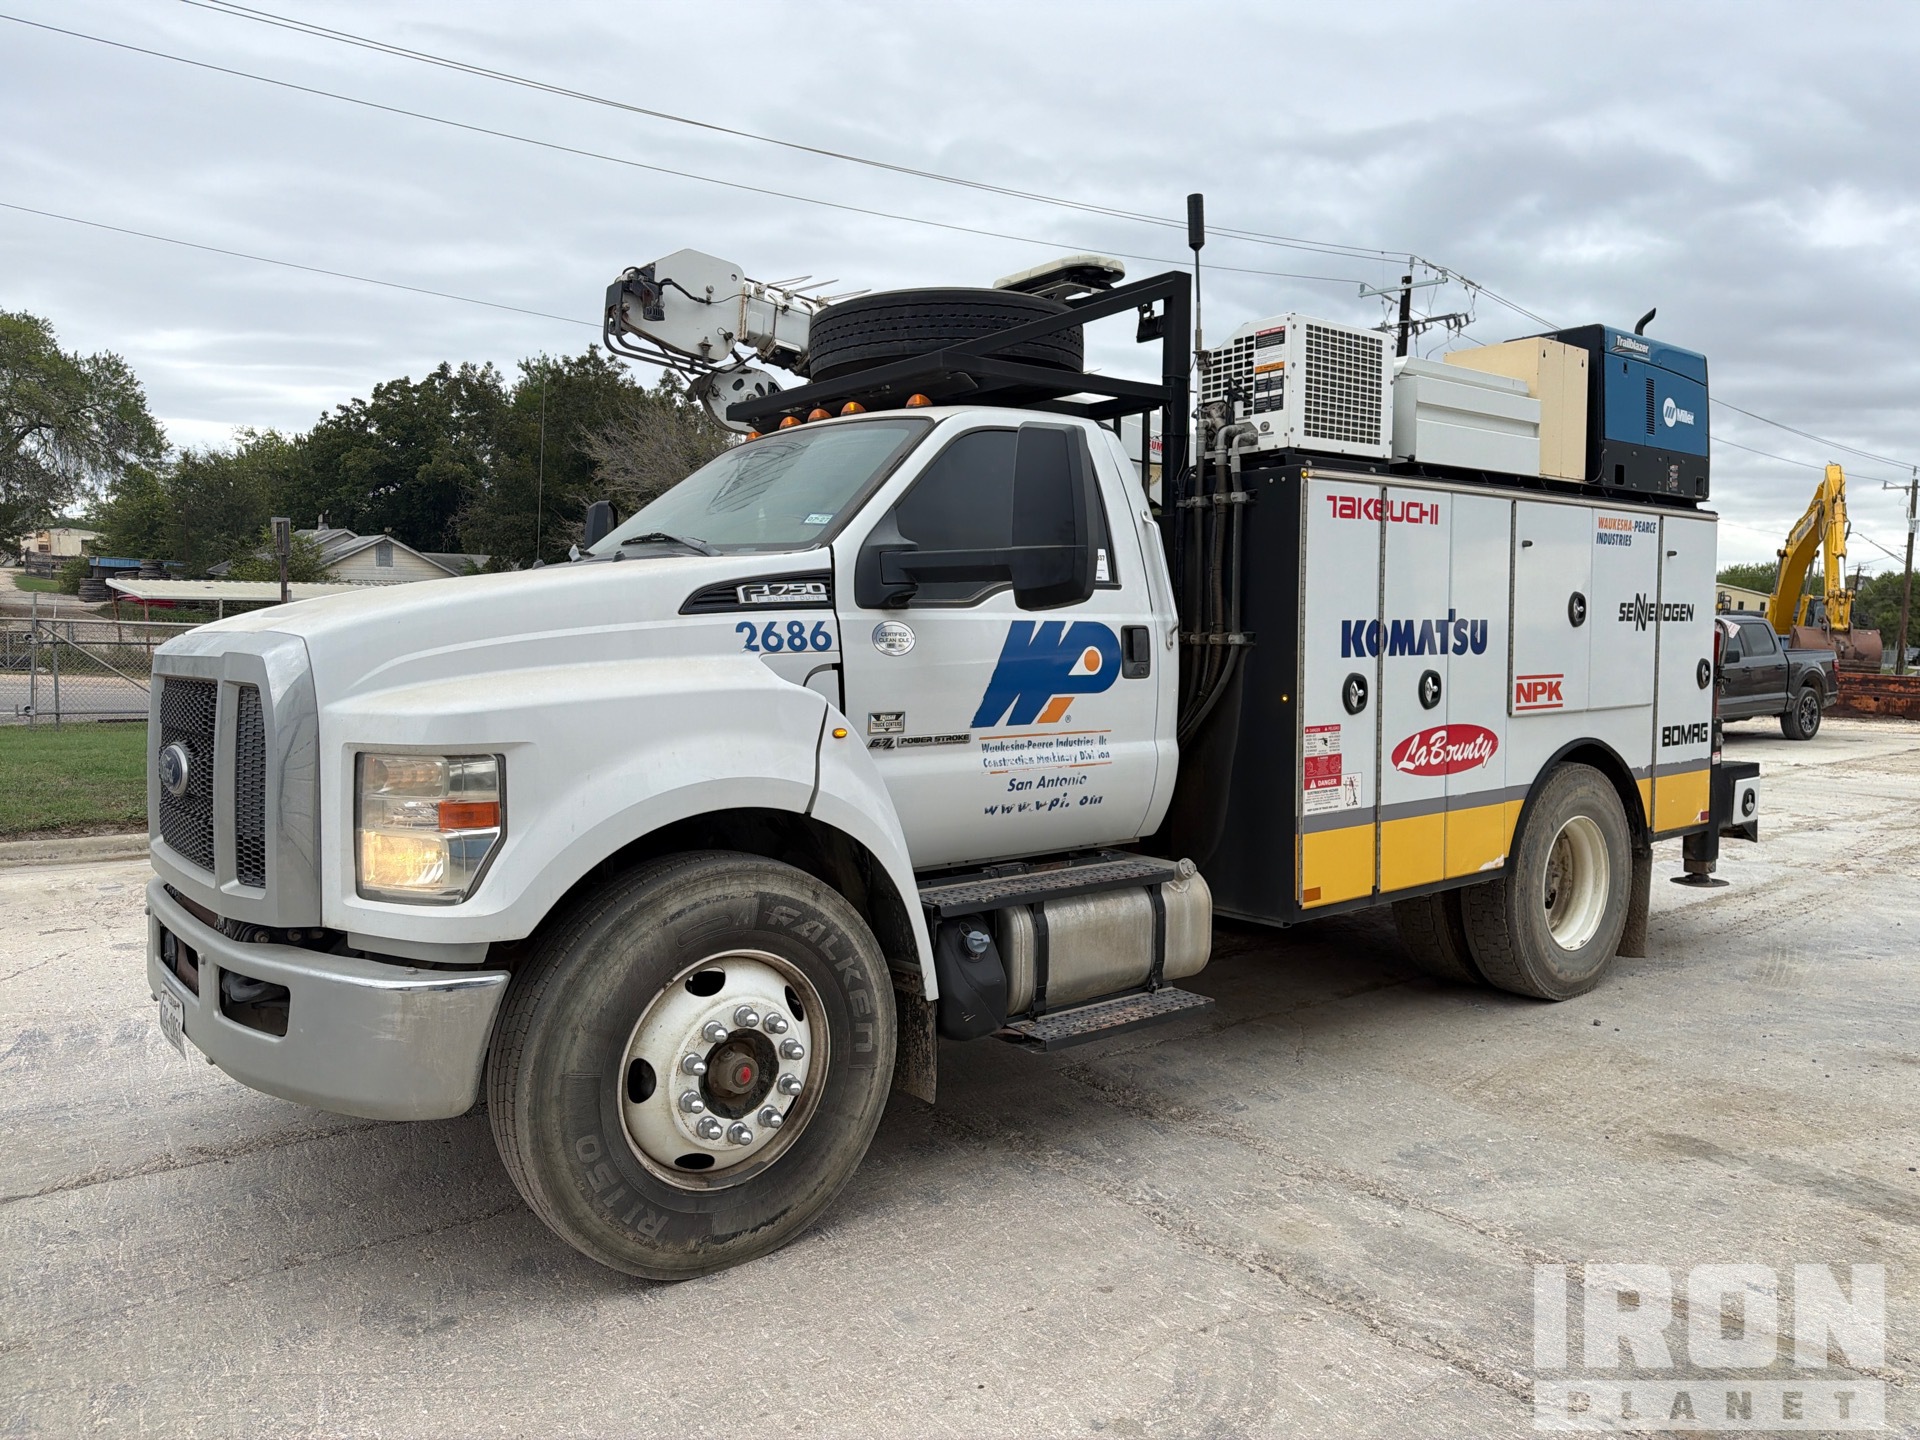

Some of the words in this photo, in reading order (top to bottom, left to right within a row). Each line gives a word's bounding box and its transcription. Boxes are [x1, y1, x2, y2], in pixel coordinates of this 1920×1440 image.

[1616, 335, 1649, 354] Trailblazer
[1676, 407, 1695, 425] Miller
[1598, 516, 1657, 534] WAUKESHA-PEARCE
[1596, 532, 1632, 547] INDUSTRIES
[1618, 593, 1694, 631] SENNEBOGEN
[735, 620, 832, 652] 2686
[1341, 608, 1488, 658] KOMATSU
[1516, 680, 1563, 703] NPK
[901, 736, 933, 744] POWER
[934, 733, 970, 742] STROKE
[1662, 722, 1708, 747] BOMAG
[1079, 750, 1110, 761] Diviion
[1396, 730, 1492, 771] LaBounty
[1007, 778, 1032, 792] San
[1036, 772, 1087, 789] Antonio
[1317, 779, 1337, 787] DANGER
[764, 905, 873, 1053] FALKEN
